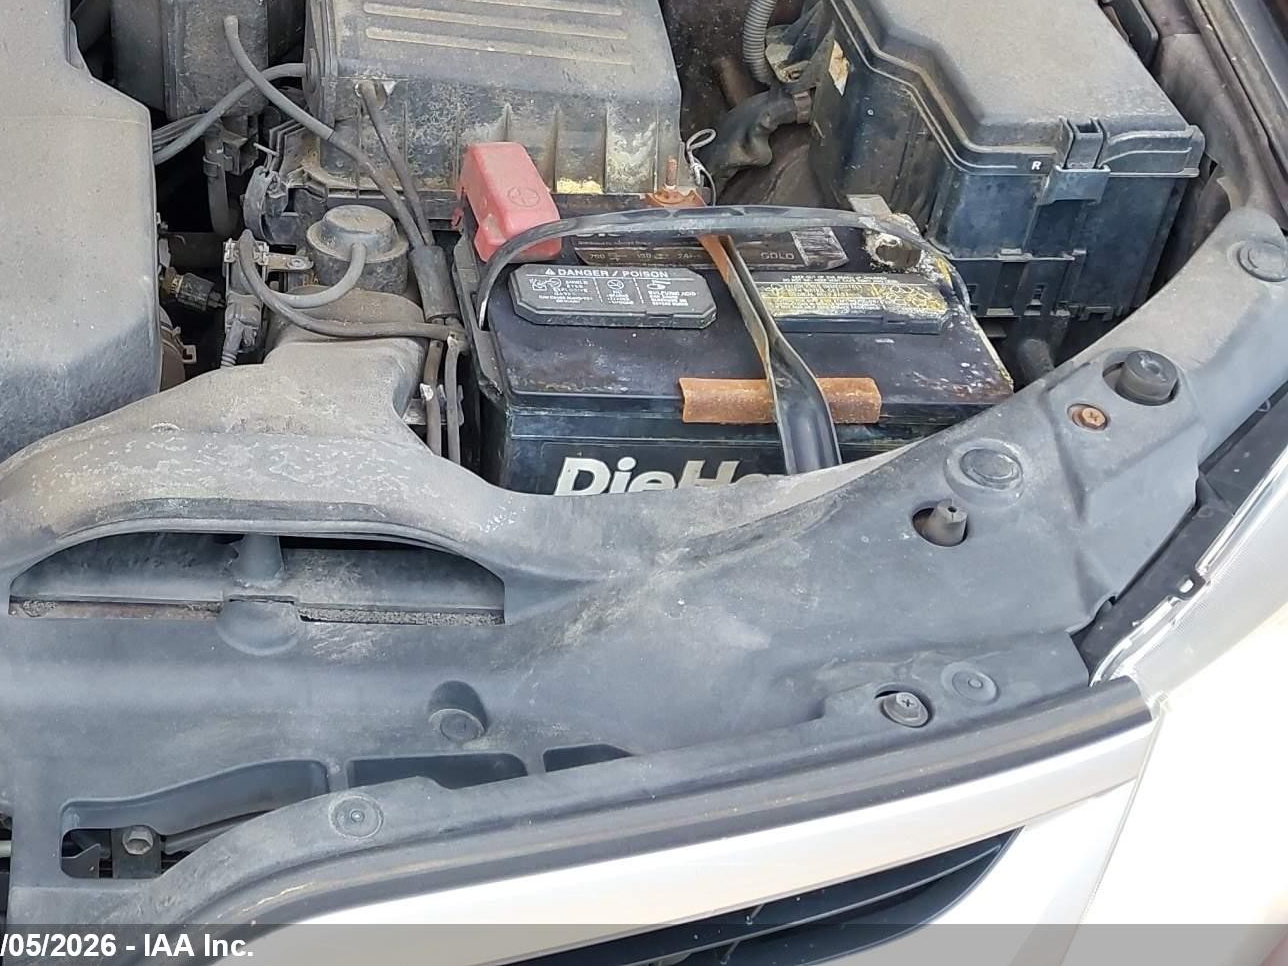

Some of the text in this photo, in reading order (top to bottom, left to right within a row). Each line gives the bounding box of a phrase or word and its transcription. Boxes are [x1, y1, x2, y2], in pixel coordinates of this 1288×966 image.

[1031, 160, 1042, 171] R
[760, 251, 795, 260] GOLD
[558, 268, 669, 278] DANGER / POISON
[554, 456, 778, 496] DieH
